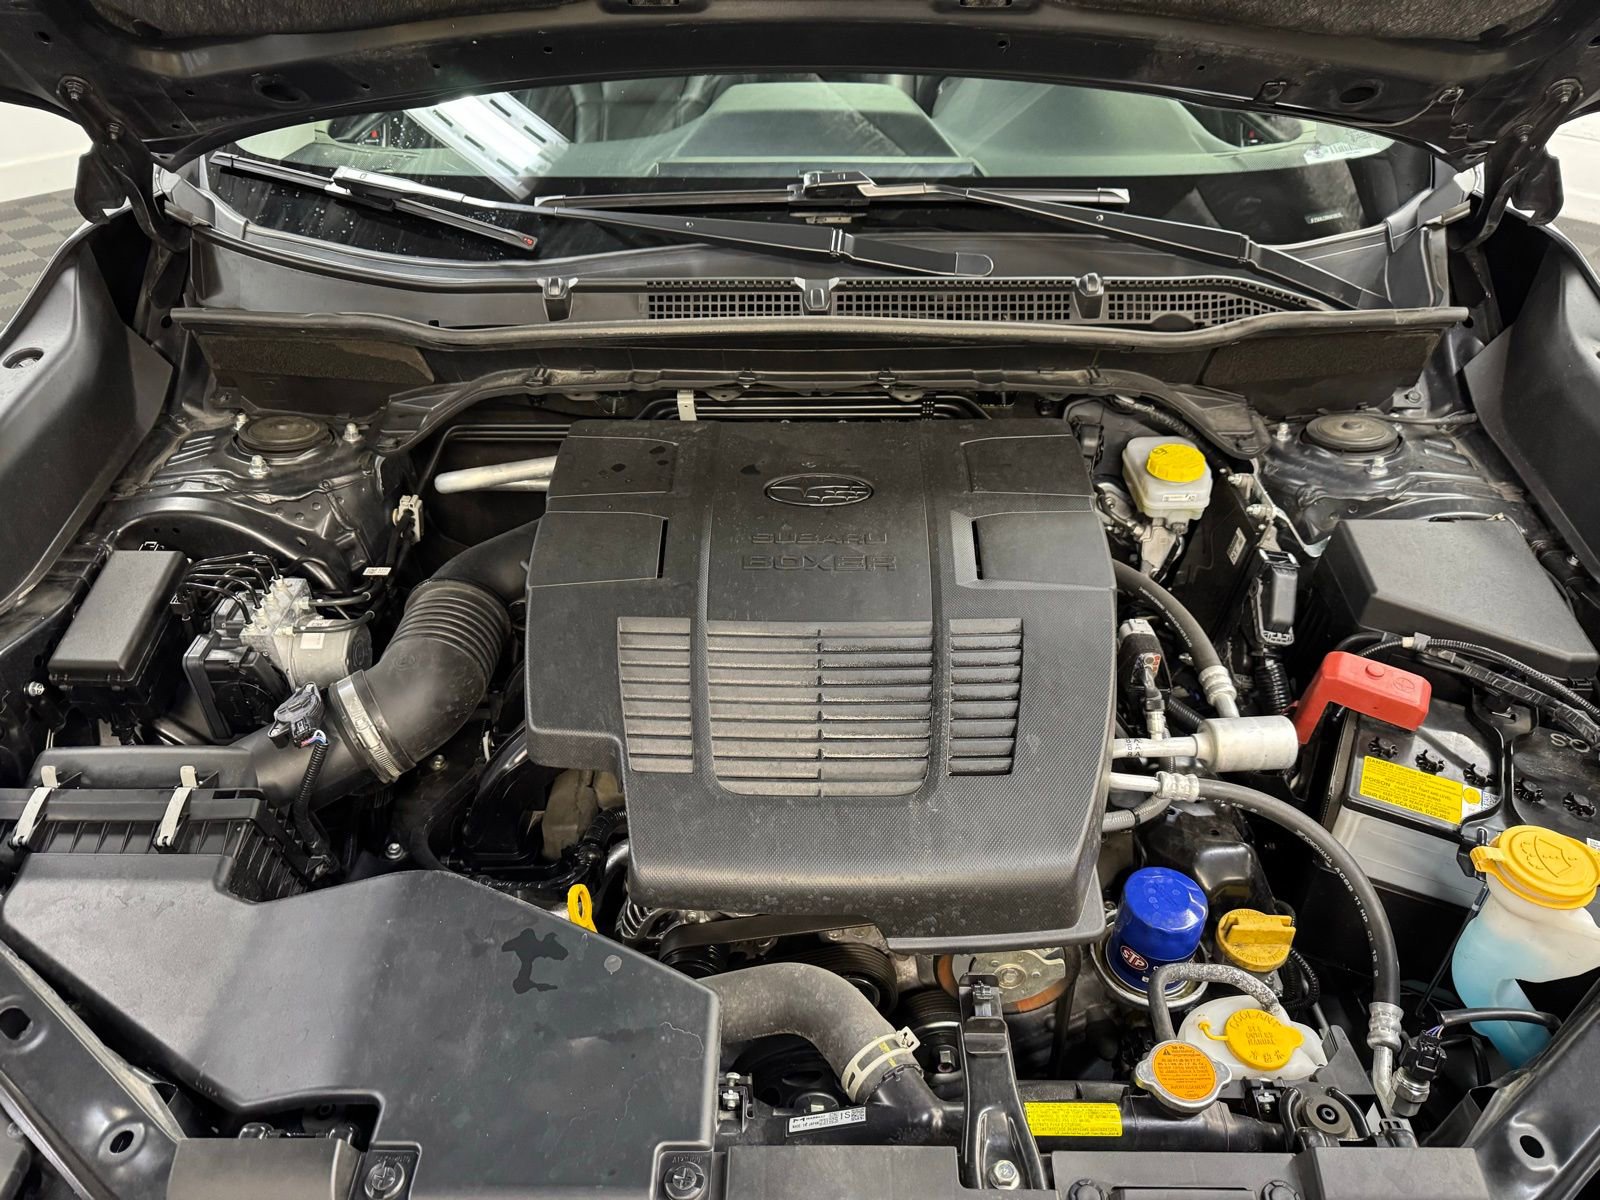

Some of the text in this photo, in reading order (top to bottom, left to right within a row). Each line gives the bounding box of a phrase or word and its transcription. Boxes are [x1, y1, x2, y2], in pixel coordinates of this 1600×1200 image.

[752, 532, 887, 544] SUBARU
[742, 554, 898, 571] BOXER
[1366, 757, 1393, 768] DANGER
[1364, 776, 1390, 786] POISON
[1304, 836, 1332, 863] YOKOHAMA
[1123, 950, 1145, 966] STP
